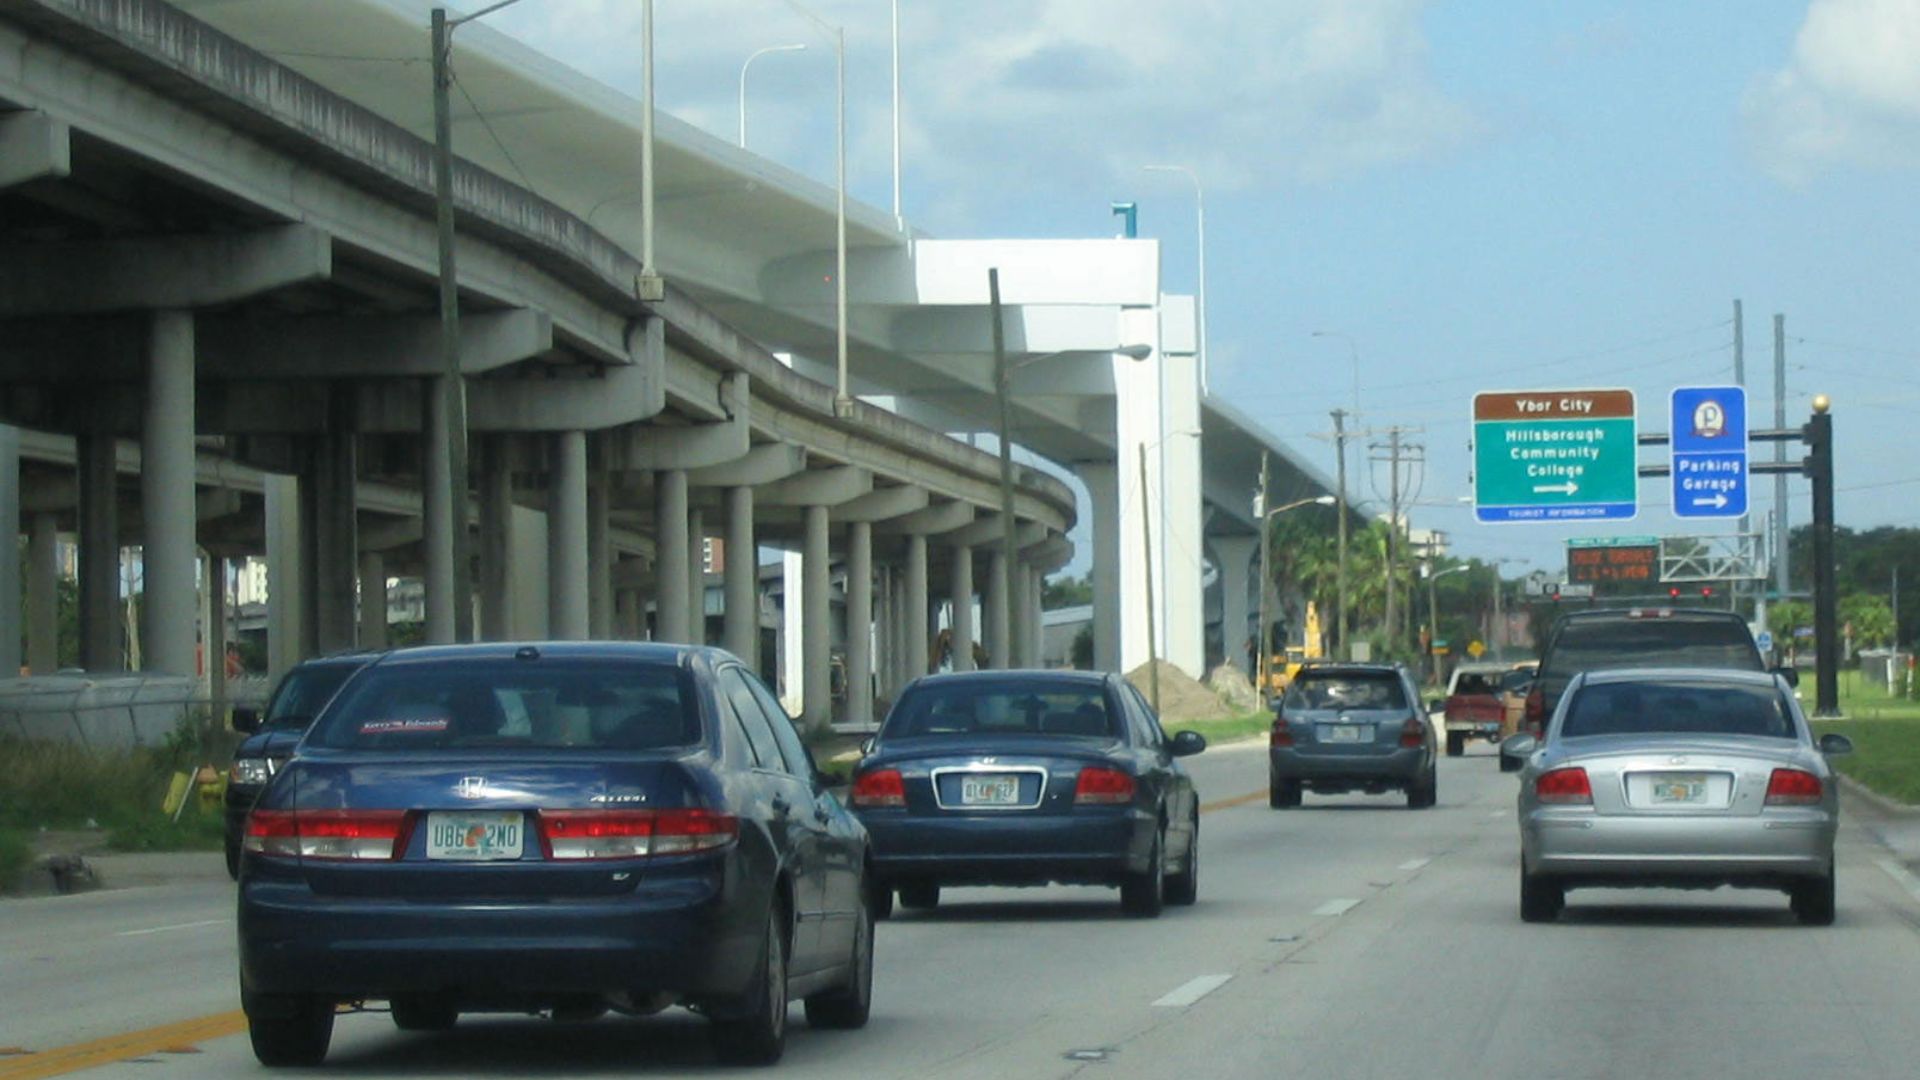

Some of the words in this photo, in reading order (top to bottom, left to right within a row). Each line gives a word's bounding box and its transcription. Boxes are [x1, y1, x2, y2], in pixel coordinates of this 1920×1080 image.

[1515, 399, 1552, 413] Ybor
[1559, 397, 1593, 413] City
[1505, 428, 1605, 443] Hillsborough
[1510, 445, 1600, 461] Community
[1527, 463, 1585, 478] College
[1679, 459, 1741, 474] Parking
[1682, 476, 1737, 493] Garage
